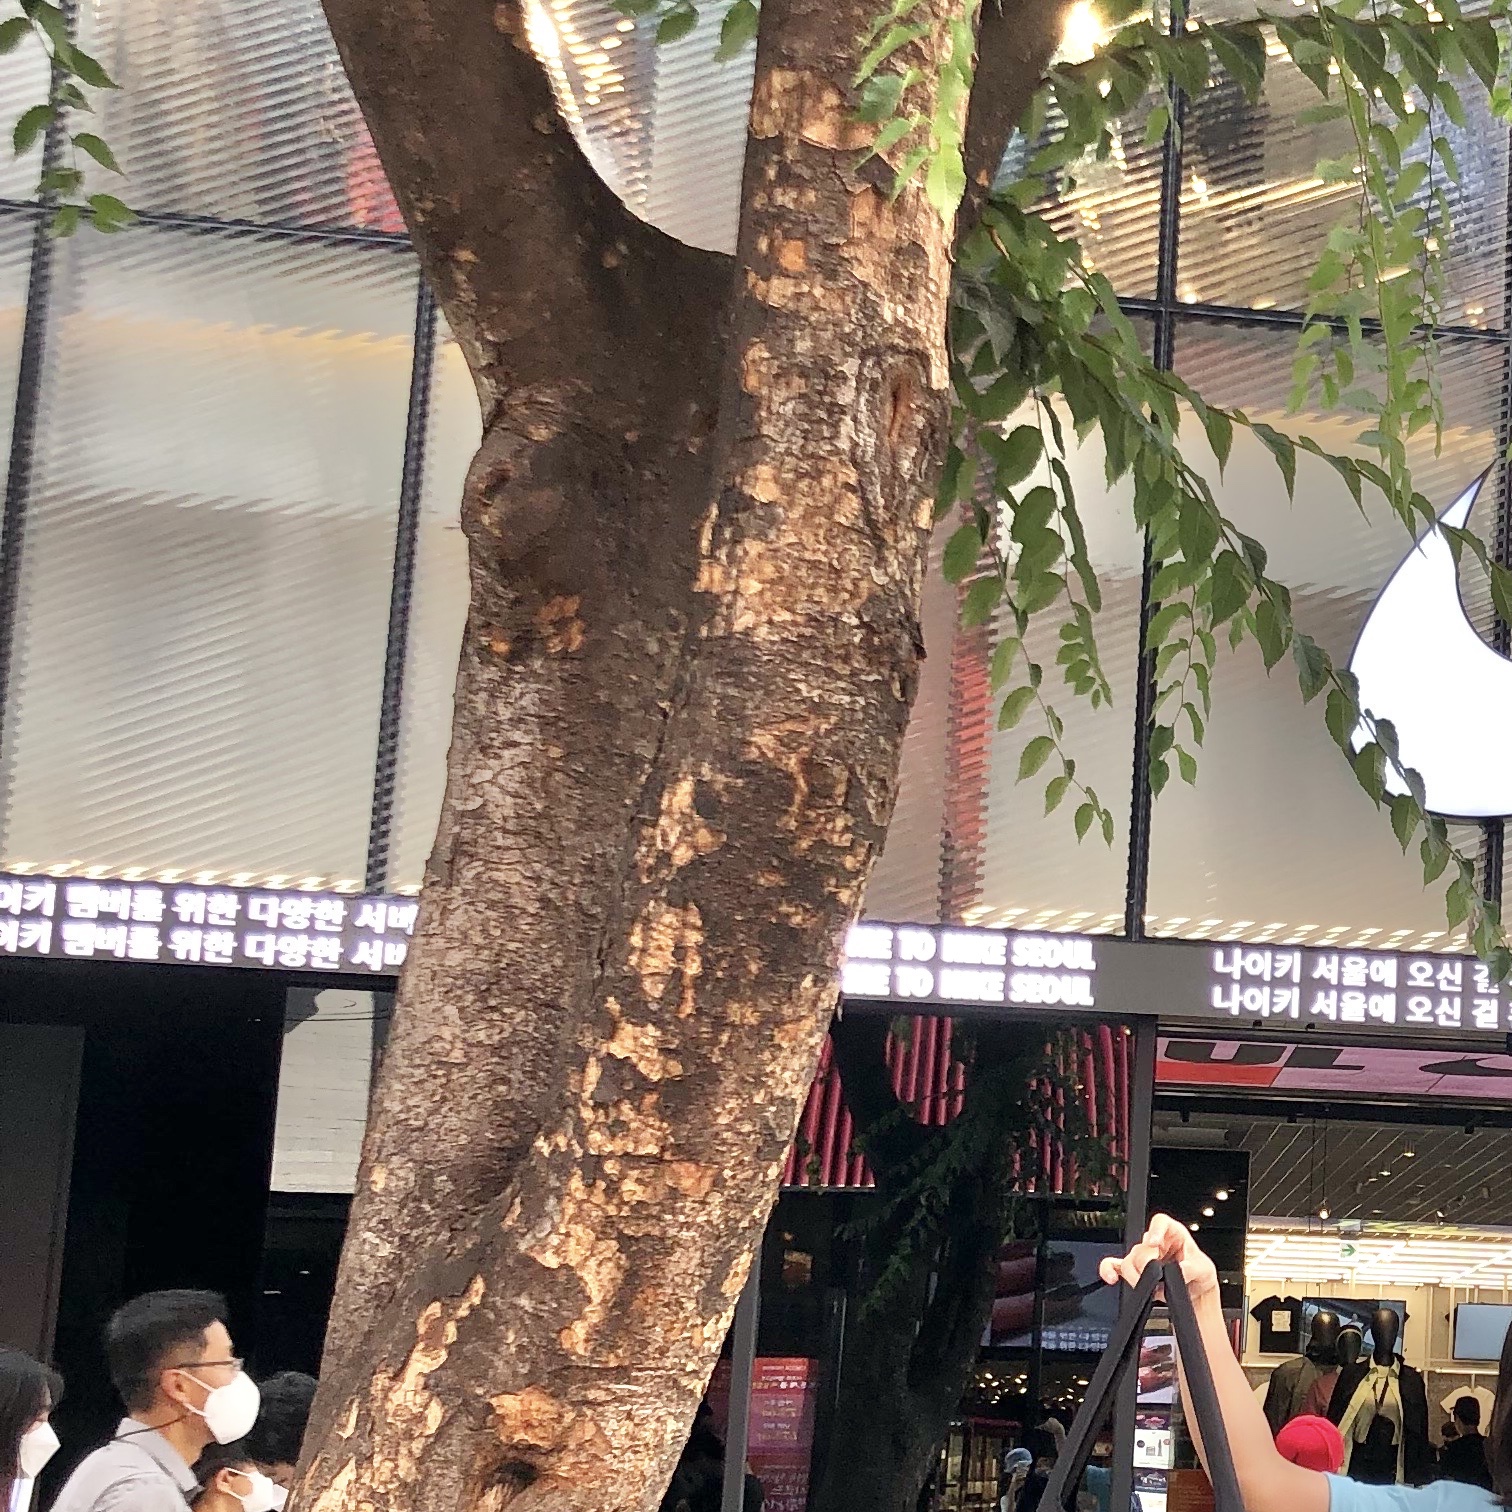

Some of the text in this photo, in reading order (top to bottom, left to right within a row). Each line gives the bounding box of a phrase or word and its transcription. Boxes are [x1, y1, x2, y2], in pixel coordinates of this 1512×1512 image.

[66, 884, 166, 924] 멤버를
[171, 892, 242, 926] 위한
[248, 896, 348, 932] 다양한
[62, 922, 161, 960] 멤버를
[167, 929, 238, 964] 위한
[244, 933, 345, 969] 다양한
[896, 929, 937, 962] TO
[940, 932, 1008, 966] NIKE
[1011, 936, 1096, 970] SEOUL
[894, 965, 935, 998] TO
[938, 968, 1006, 1002] NIKE
[1008, 972, 1094, 1006] SEOUL
[1214, 948, 1301, 983] 나이키
[1312, 955, 1397, 989] 서울에
[1406, 961, 1462, 992] 오신
[1213, 984, 1300, 1019] 나이키
[1310, 990, 1396, 1023] 서울에
[1405, 995, 1461, 1027] 오신
[1471, 998, 1499, 1029] 걸
